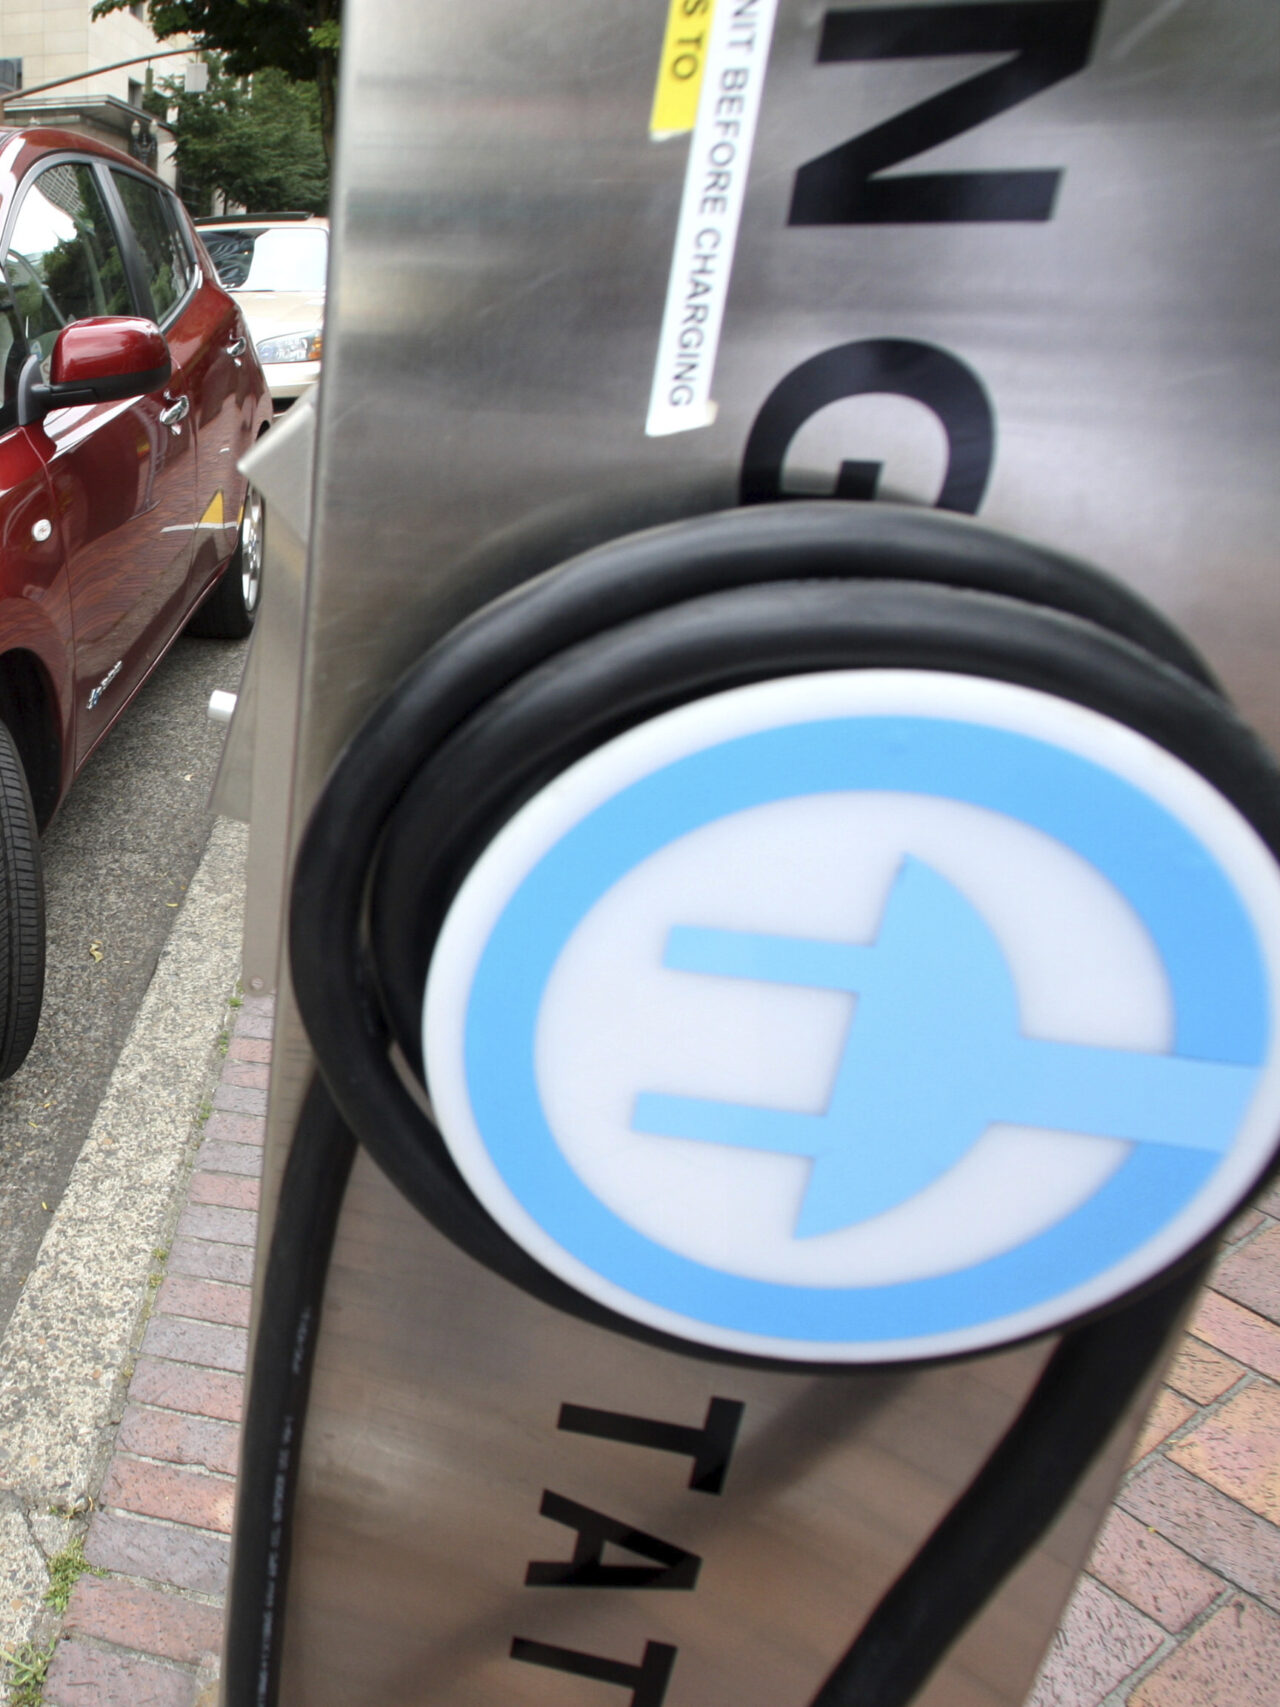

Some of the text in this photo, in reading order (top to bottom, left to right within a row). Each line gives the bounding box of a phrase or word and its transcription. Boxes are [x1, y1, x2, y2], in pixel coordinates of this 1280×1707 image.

[671, 31, 705, 82] TO
[699, 67, 750, 215] BEFORE
[668, 227, 722, 407] CHARGING
